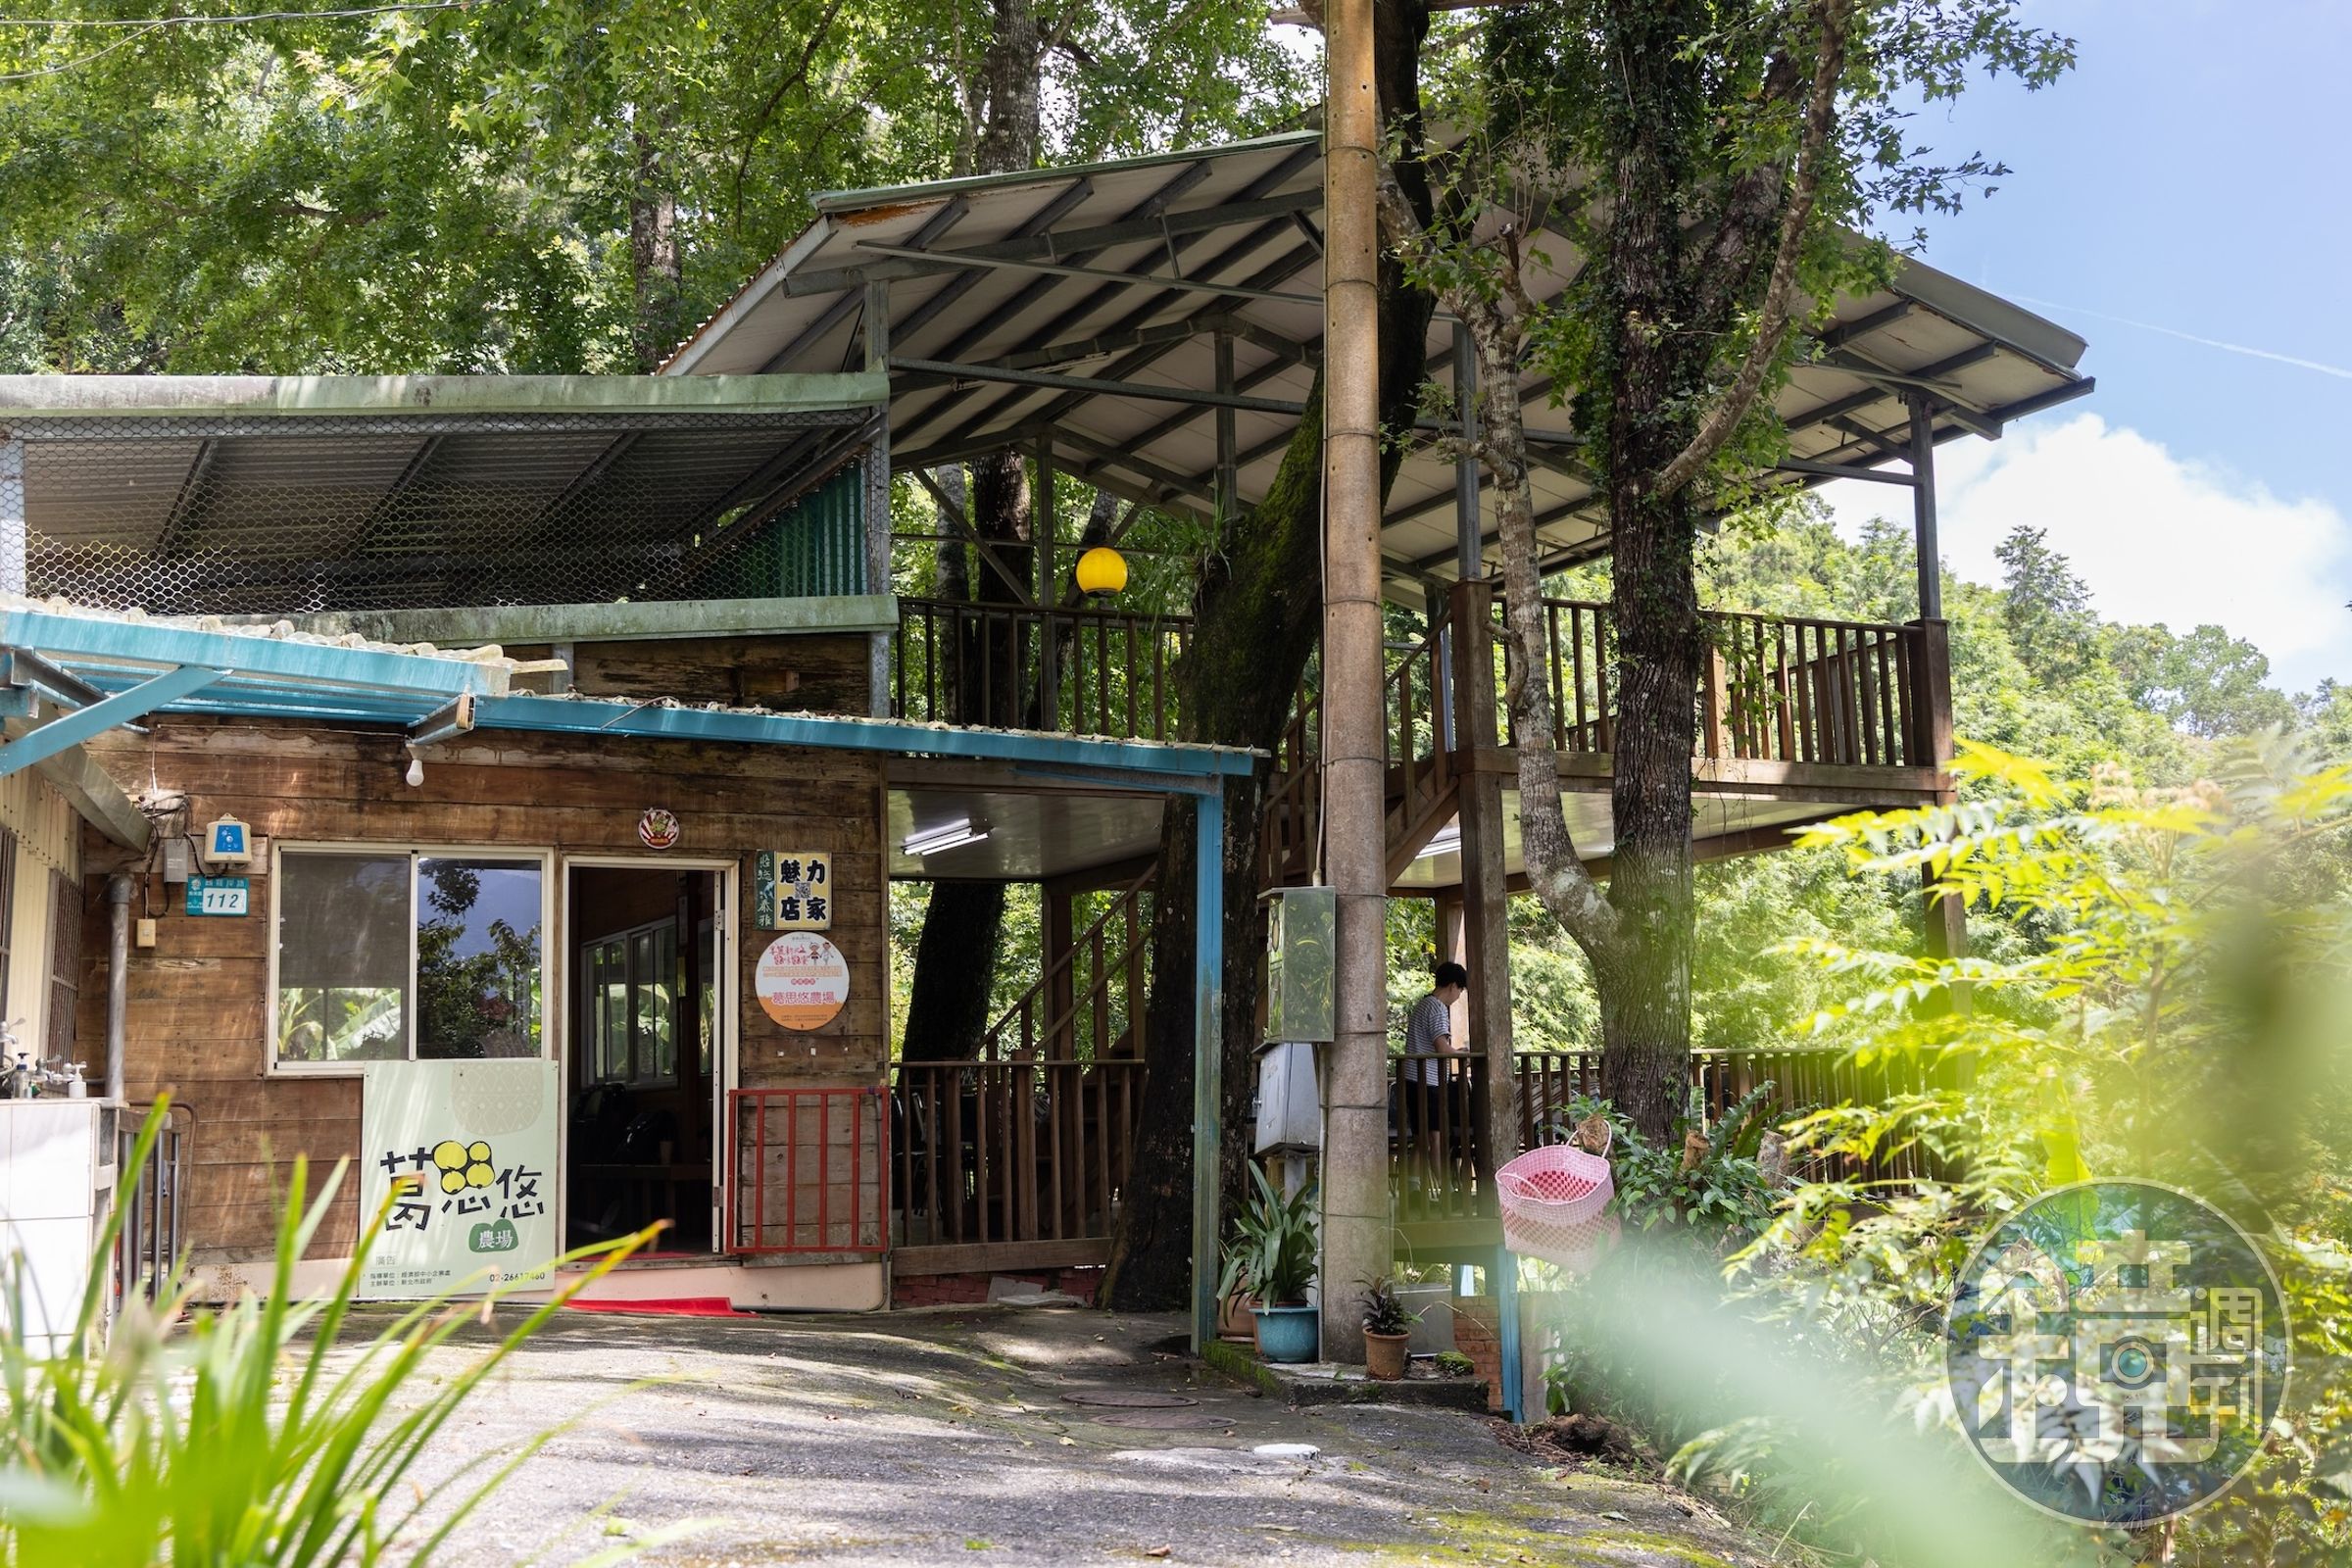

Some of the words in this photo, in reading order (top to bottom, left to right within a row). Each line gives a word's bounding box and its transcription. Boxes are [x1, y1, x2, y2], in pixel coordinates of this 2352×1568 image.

[781, 859, 825, 884] 魅力
[208, 894, 238, 908] 112
[781, 897, 826, 920] 店家
[773, 992, 835, 1004] 葛思悠農場
[479, 1230, 514, 1249] 農場
